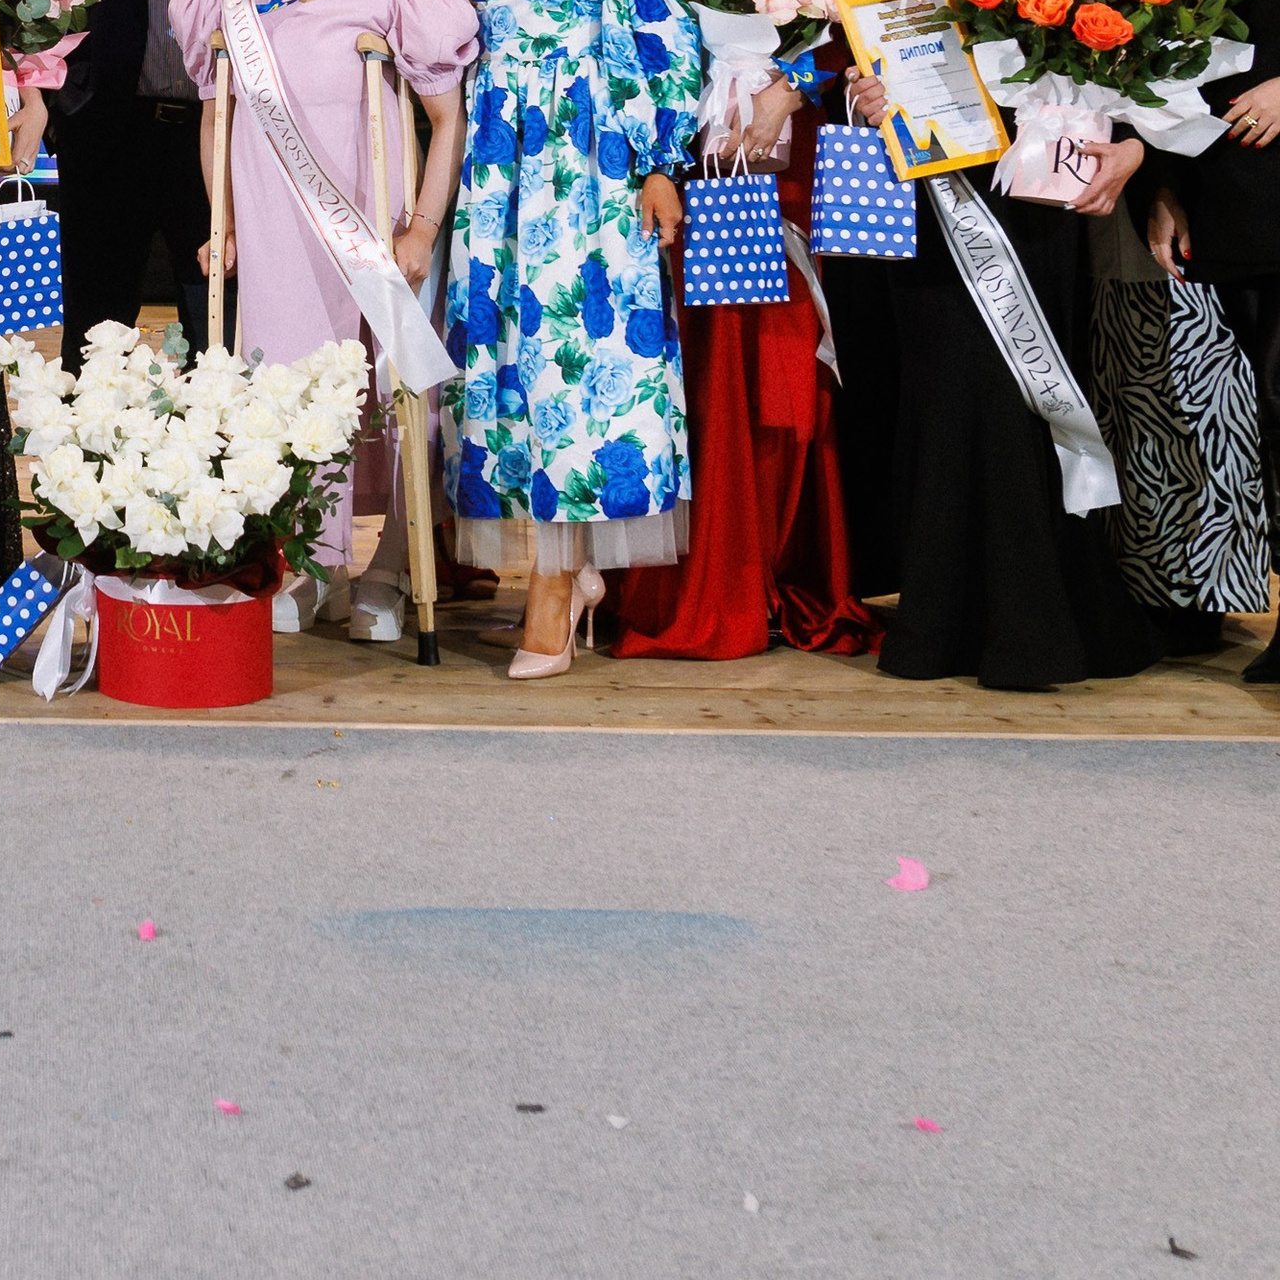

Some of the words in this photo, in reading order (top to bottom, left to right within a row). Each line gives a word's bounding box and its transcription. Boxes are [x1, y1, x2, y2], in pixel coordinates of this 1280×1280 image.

[232, 7, 268, 86] WOMEN
[899, 41, 945, 62] ДИПЛОМ
[251, 102, 270, 128] place
[117, 605, 201, 642] ROYAL
